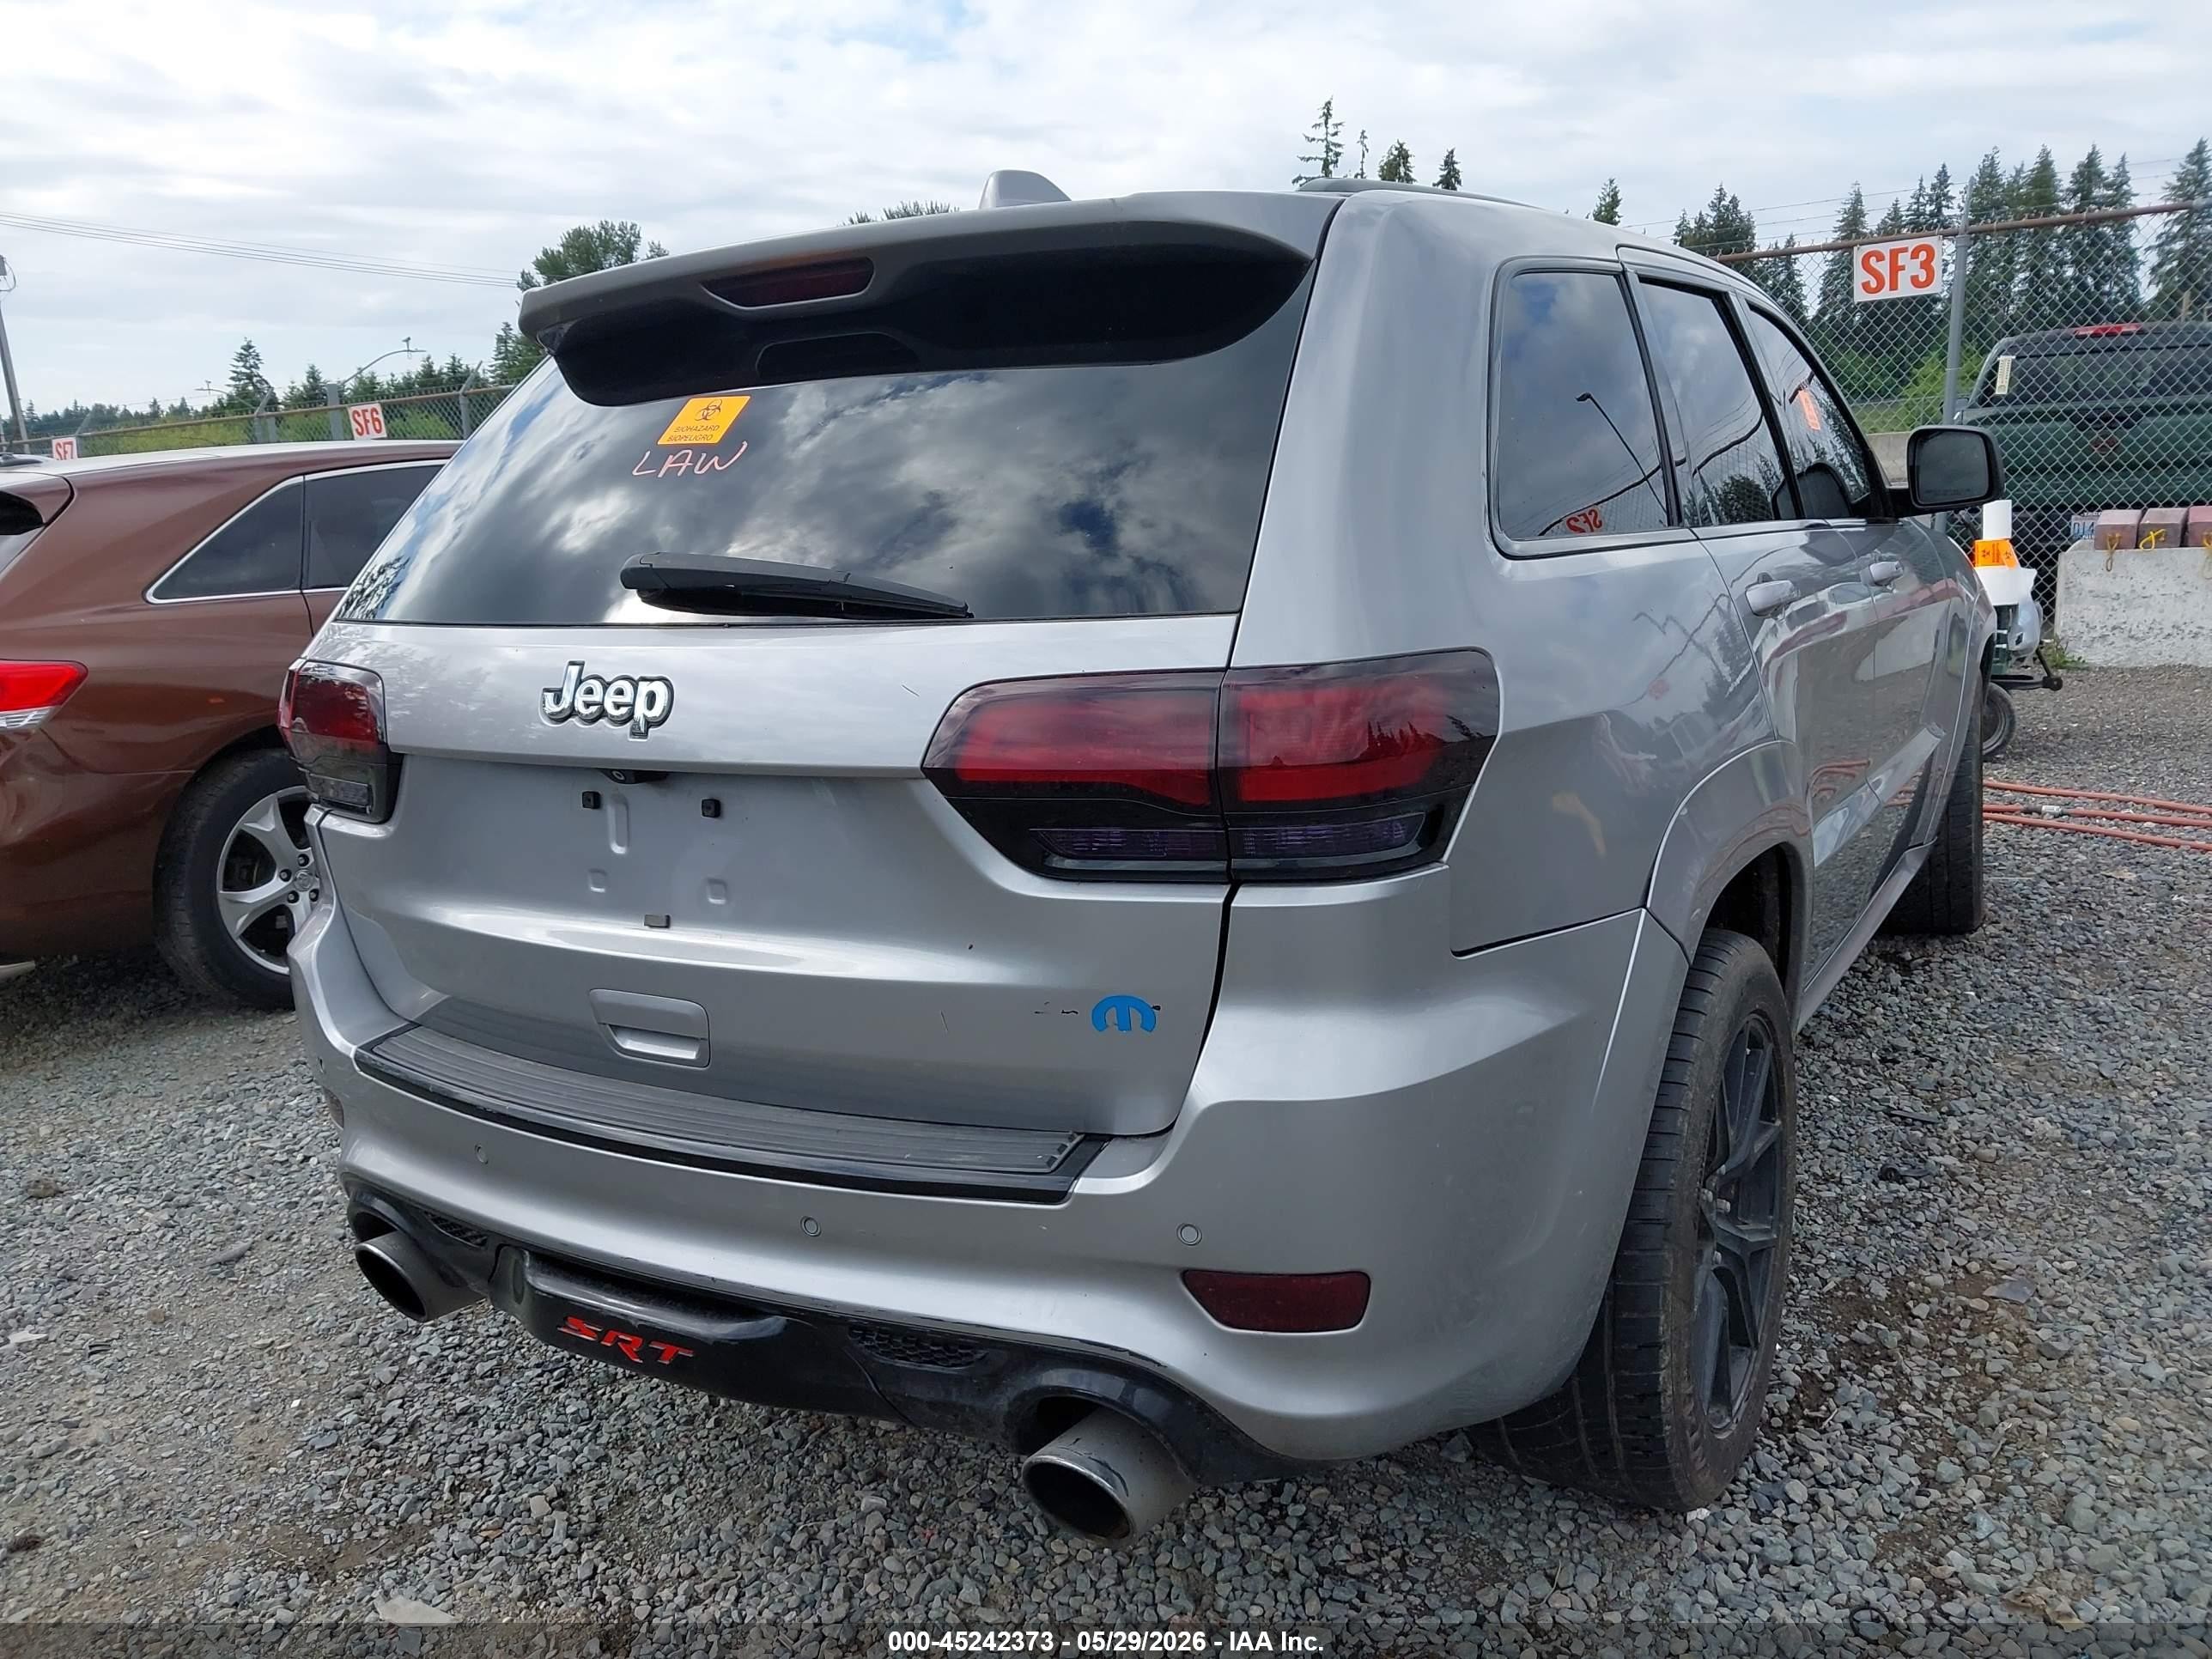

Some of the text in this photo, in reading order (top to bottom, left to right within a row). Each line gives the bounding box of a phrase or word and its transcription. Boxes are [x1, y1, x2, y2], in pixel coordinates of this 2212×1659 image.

[1861, 244, 1936, 295] SF3
[352, 408, 383, 436] SF6
[674, 424, 720, 433] BIOHAZARD
[55, 441, 74, 460] SF7
[632, 441, 748, 478] LAW
[540, 660, 674, 740] Jeep
[557, 1316, 695, 1364] SRT
